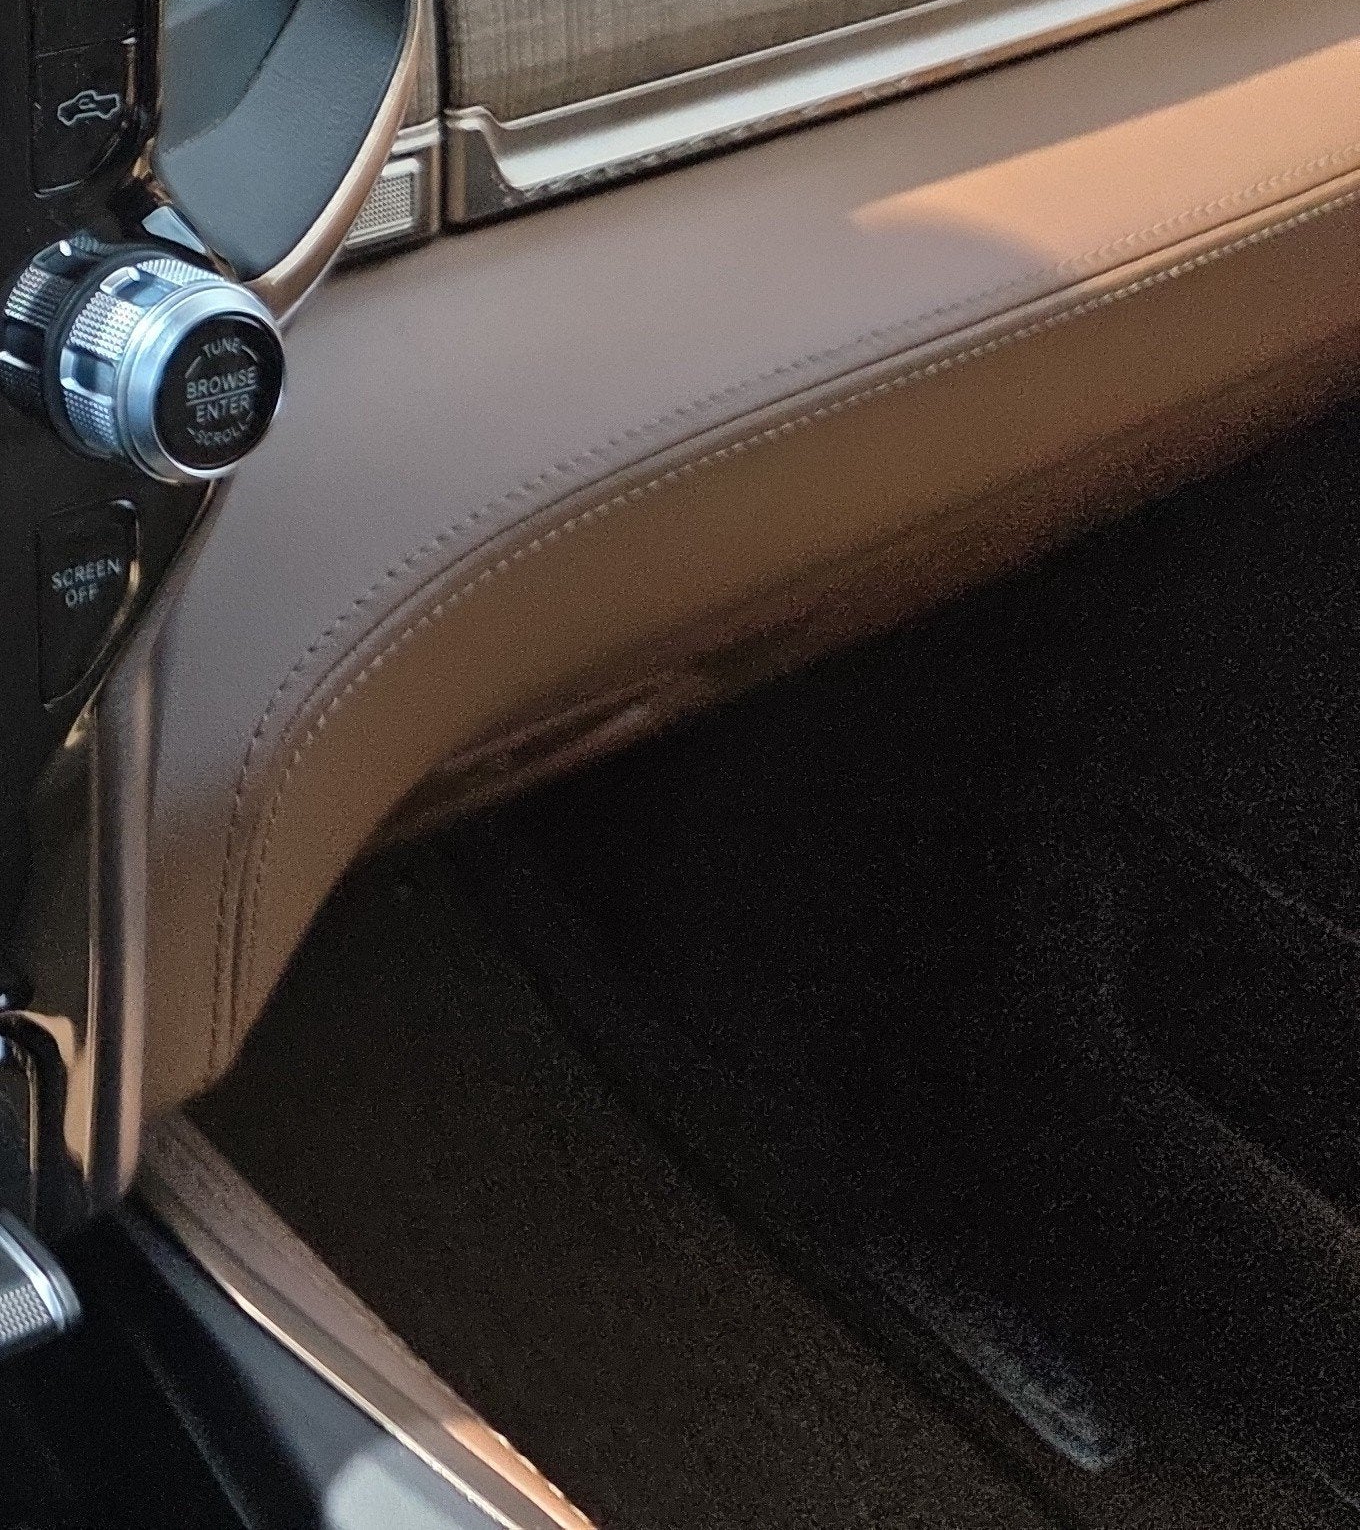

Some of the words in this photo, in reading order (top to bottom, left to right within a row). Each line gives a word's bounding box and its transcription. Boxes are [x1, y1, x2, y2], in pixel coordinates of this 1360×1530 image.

[201, 337, 241, 358] TUNE
[187, 366, 257, 399] BROWSE
[196, 394, 250, 423] ENTER
[51, 556, 123, 591] SCREEN
[65, 582, 100, 609] OFF
